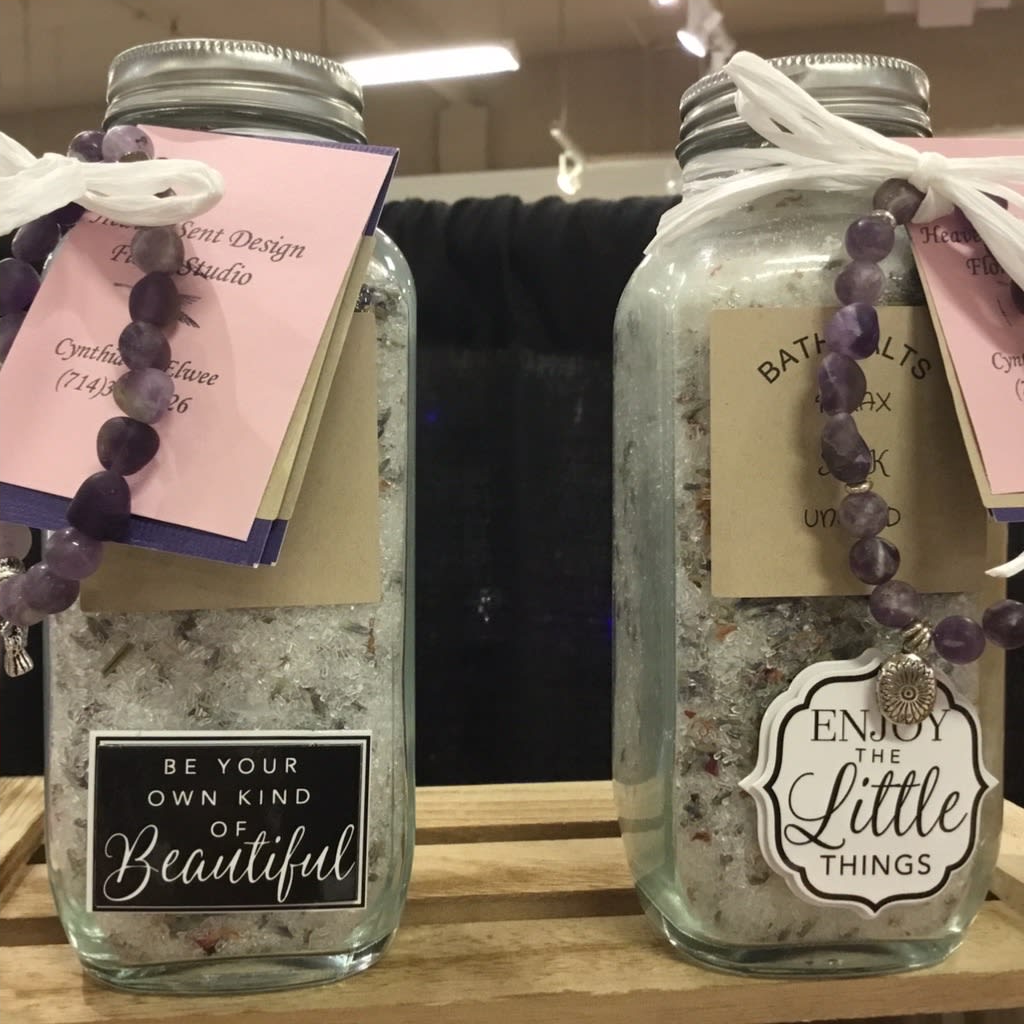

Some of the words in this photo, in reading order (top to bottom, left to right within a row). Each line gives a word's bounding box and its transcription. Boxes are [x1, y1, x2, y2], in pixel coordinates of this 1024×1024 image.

[176, 219, 226, 245] Sent
[228, 228, 307, 263] Design
[177, 256, 253, 286] Studio
[164, 758, 197, 775] BE
[218, 757, 298, 775] YOUR
[855, 748, 901, 764] THE
[147, 789, 217, 807] OWN
[239, 788, 311, 805] KIND
[784, 761, 969, 851] Little
[210, 820, 248, 838] OF
[103, 823, 357, 903] Beautiful
[820, 853, 932, 876] THINGS
